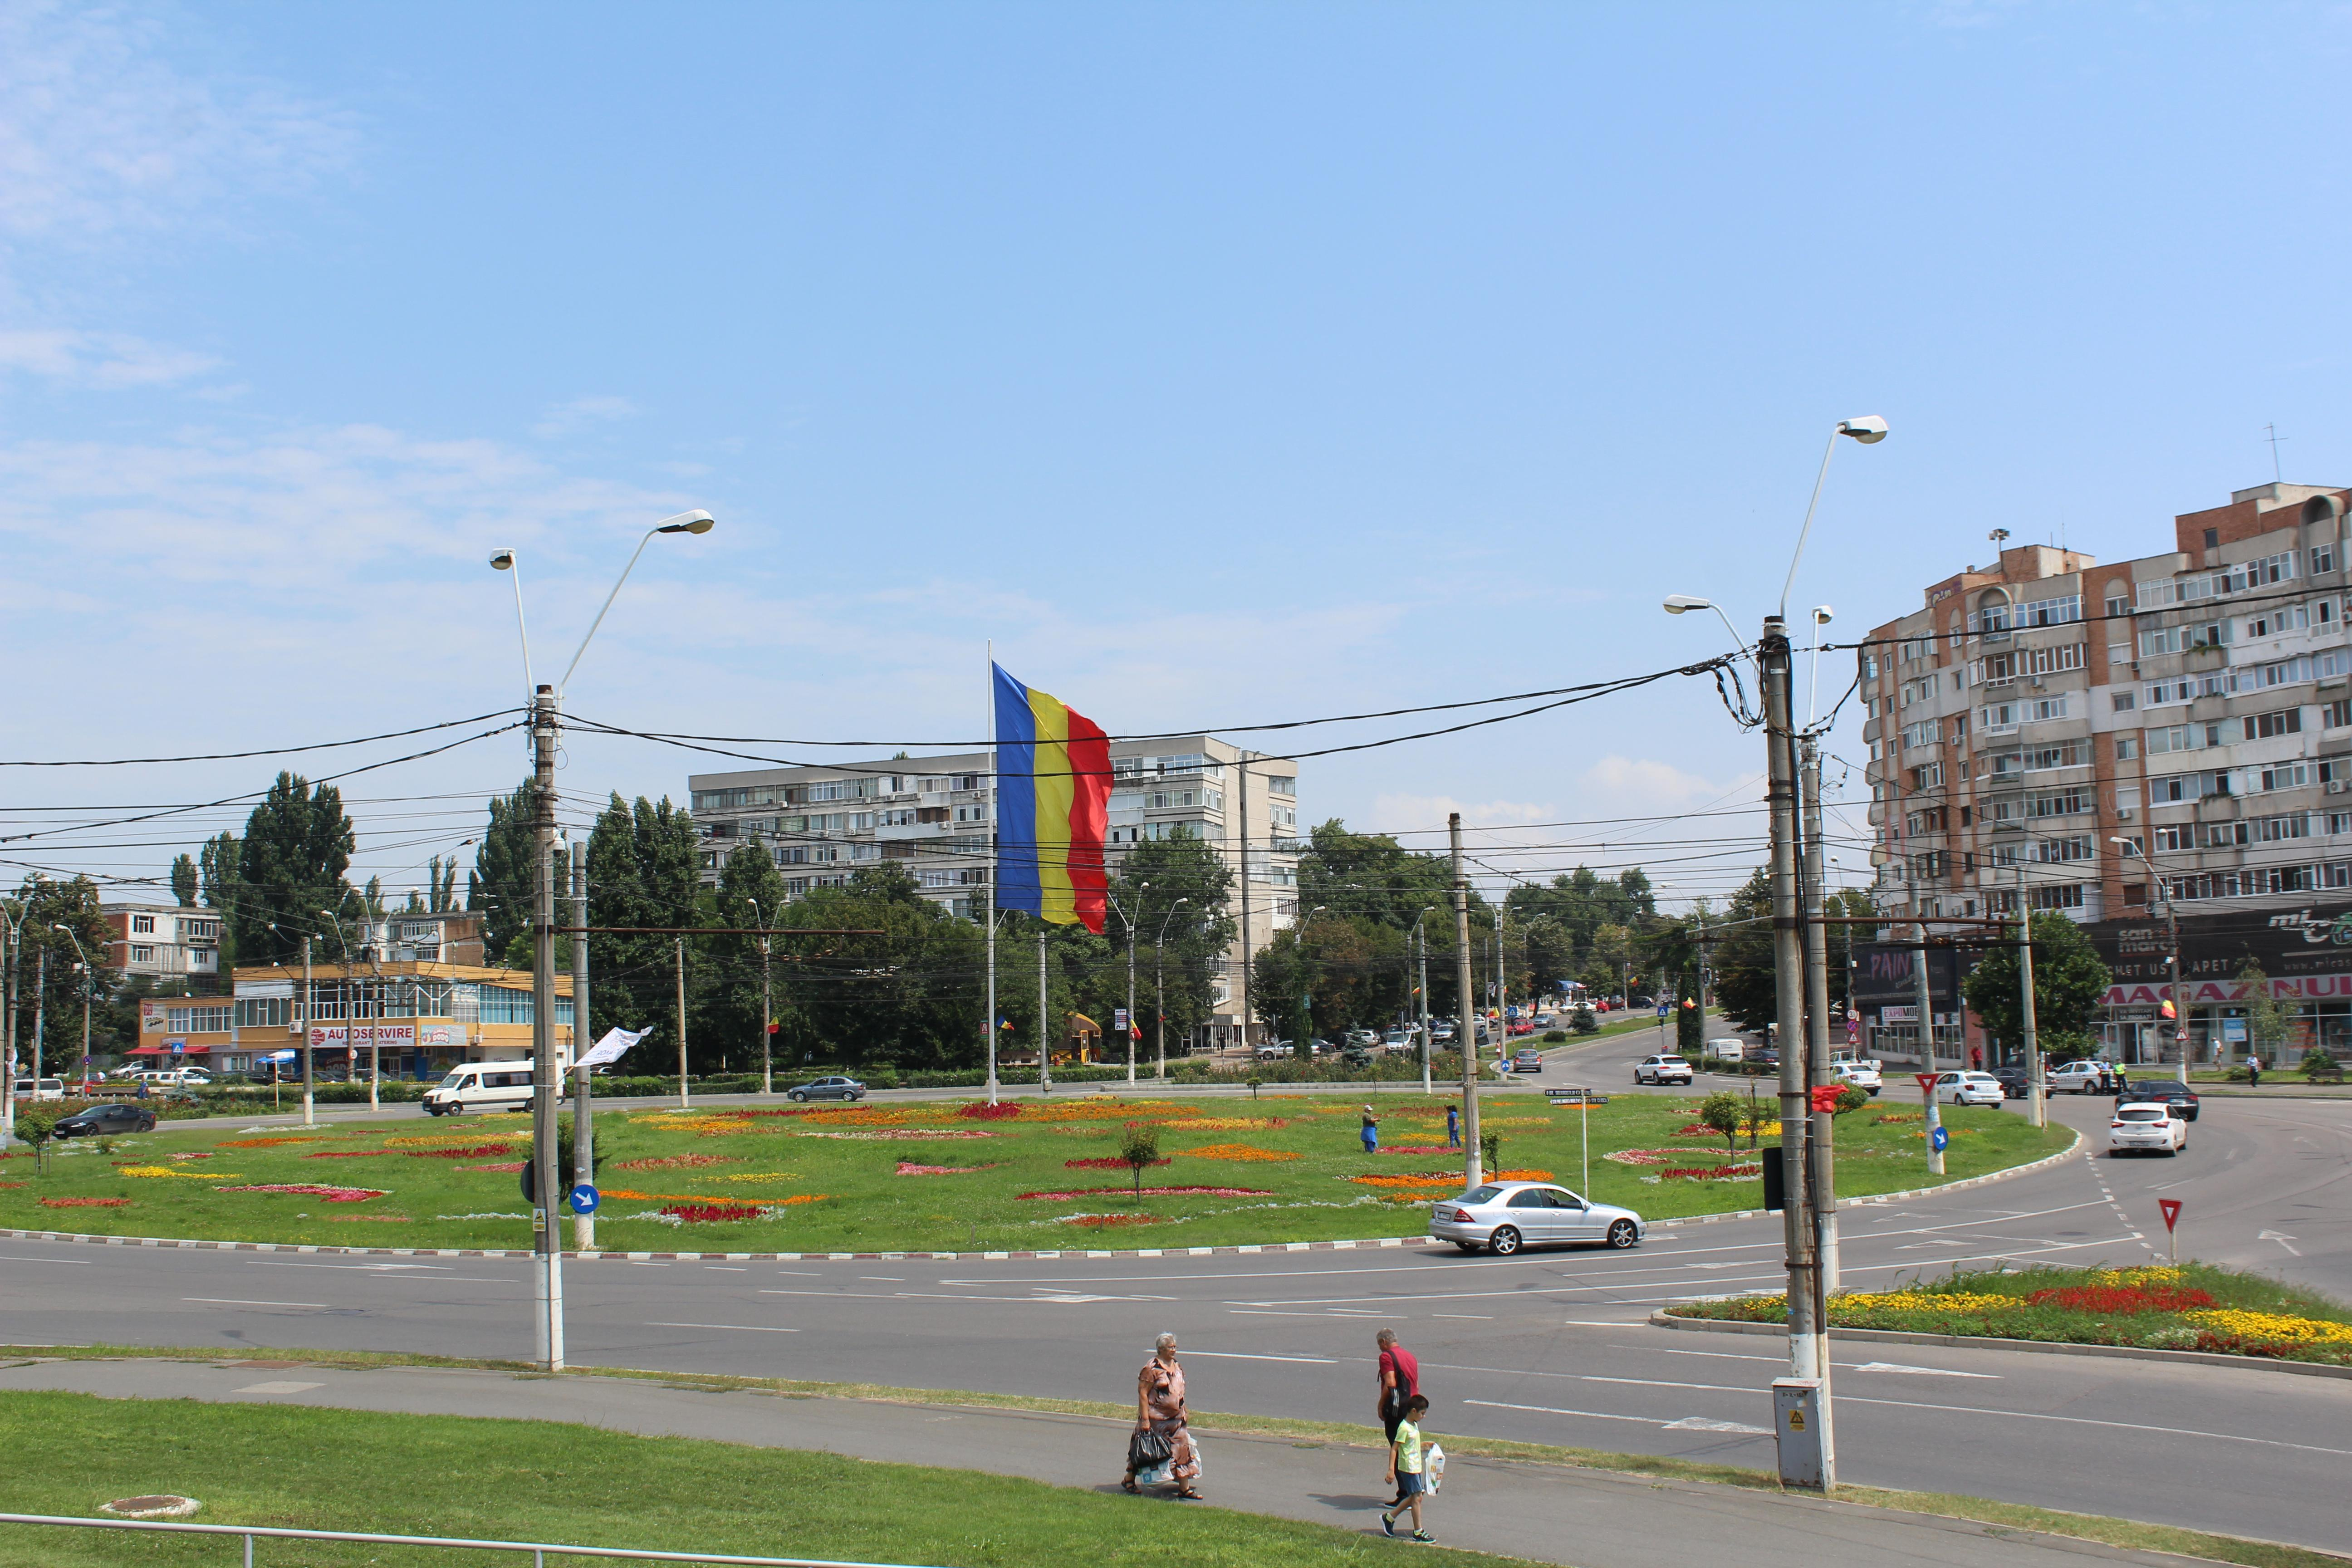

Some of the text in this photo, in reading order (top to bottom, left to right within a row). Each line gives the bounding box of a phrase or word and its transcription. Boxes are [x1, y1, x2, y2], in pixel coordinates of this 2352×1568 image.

[2118, 929, 2153, 941] san
[1871, 952, 1911, 981] PAIN
[2149, 964, 2168, 975] US
[2192, 959, 2229, 973] APET
[328, 1027, 412, 1039] AUTOSERVIRE
[433, 1034, 449, 1043] DODO
